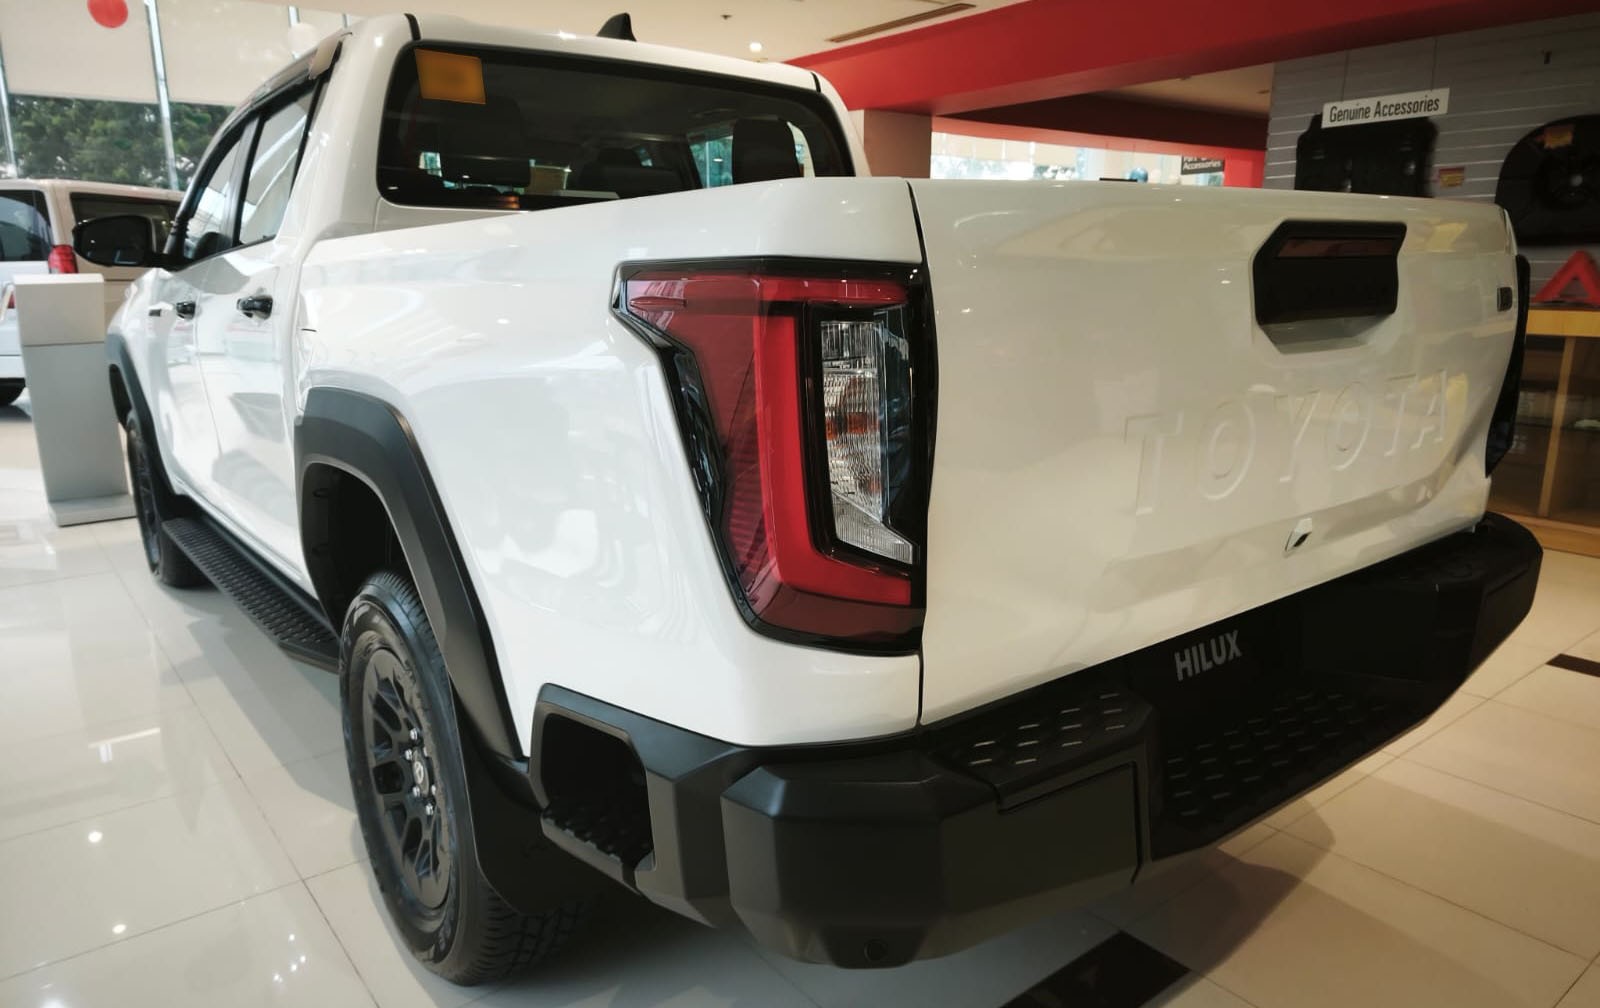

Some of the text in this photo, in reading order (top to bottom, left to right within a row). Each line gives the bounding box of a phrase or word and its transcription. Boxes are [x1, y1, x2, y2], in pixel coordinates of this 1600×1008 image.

[1329, 95, 1440, 123] Genuine Accessories
[1183, 159, 1221, 170] Accessories
[1123, 369, 1448, 516] TOYOTA
[1174, 630, 1243, 681] HILUX
